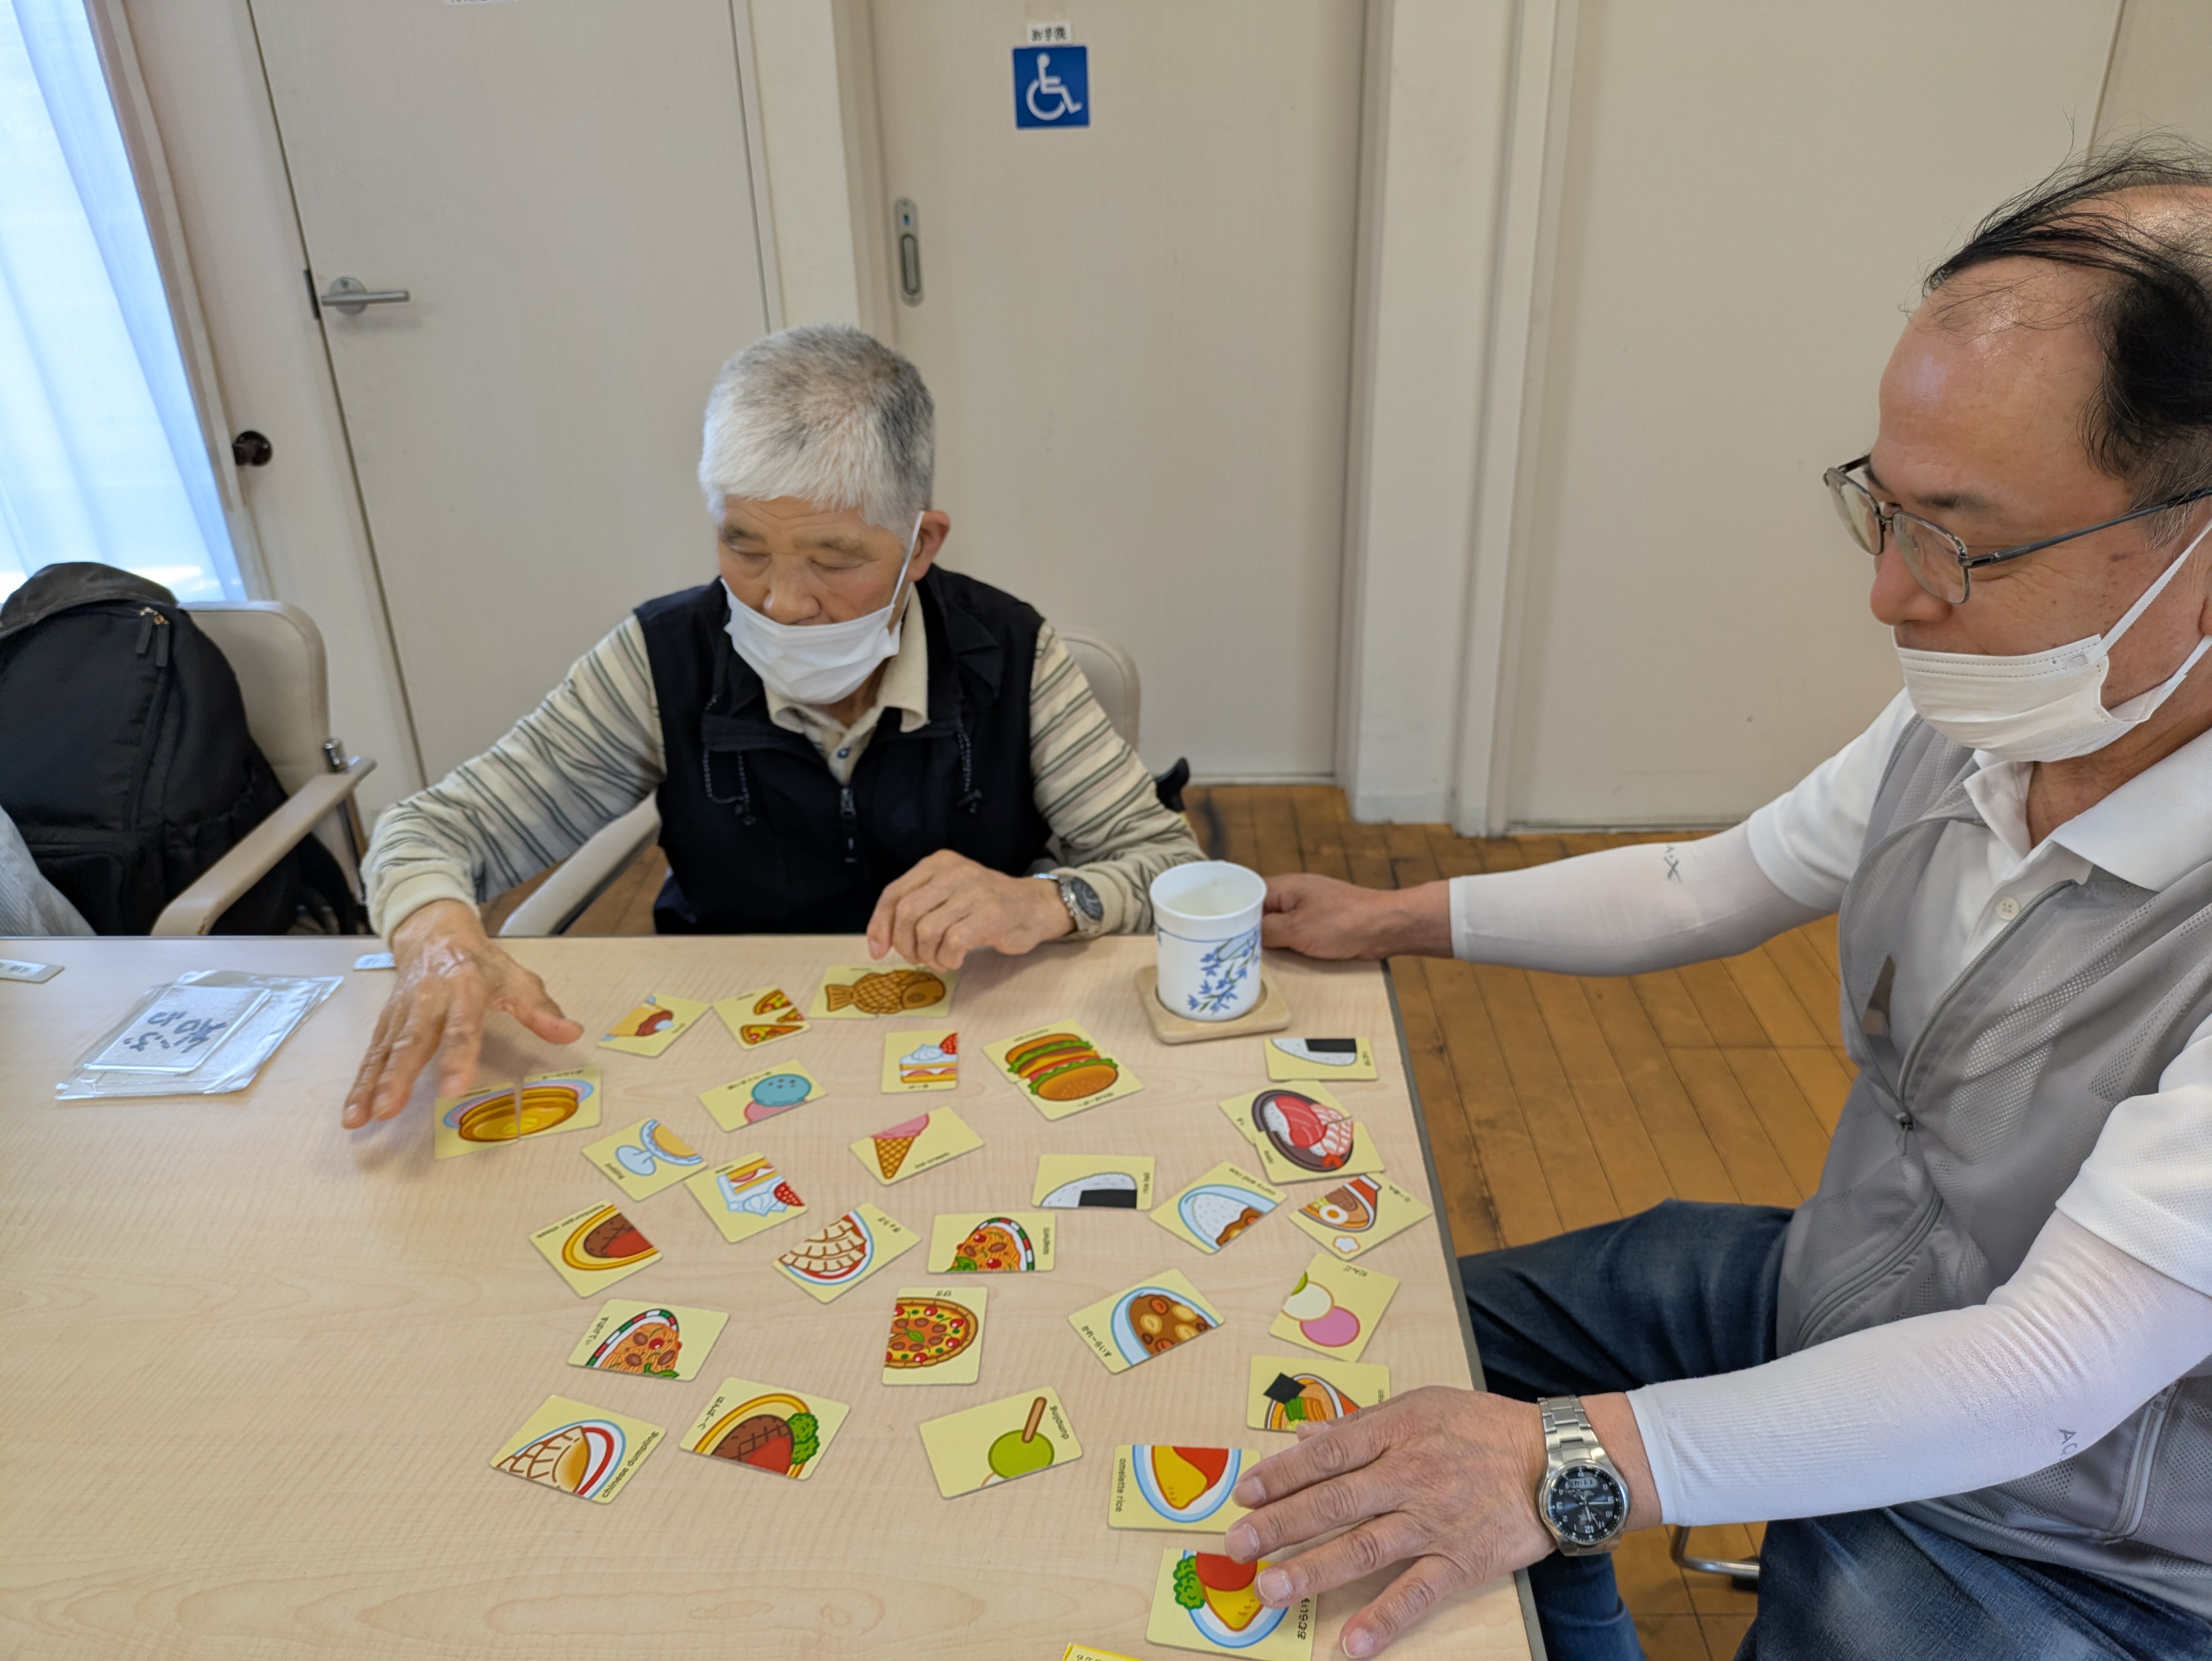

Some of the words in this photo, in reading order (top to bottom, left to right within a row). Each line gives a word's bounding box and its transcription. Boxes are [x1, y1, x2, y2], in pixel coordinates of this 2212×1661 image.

[1049, 1405, 1070, 1440] dumpling
[601, 1467, 630, 1498] chinese
[627, 1430, 659, 1467] dumpling
[1116, 1458, 1126, 1494] omelette
[1115, 1495, 1125, 1512] rice
